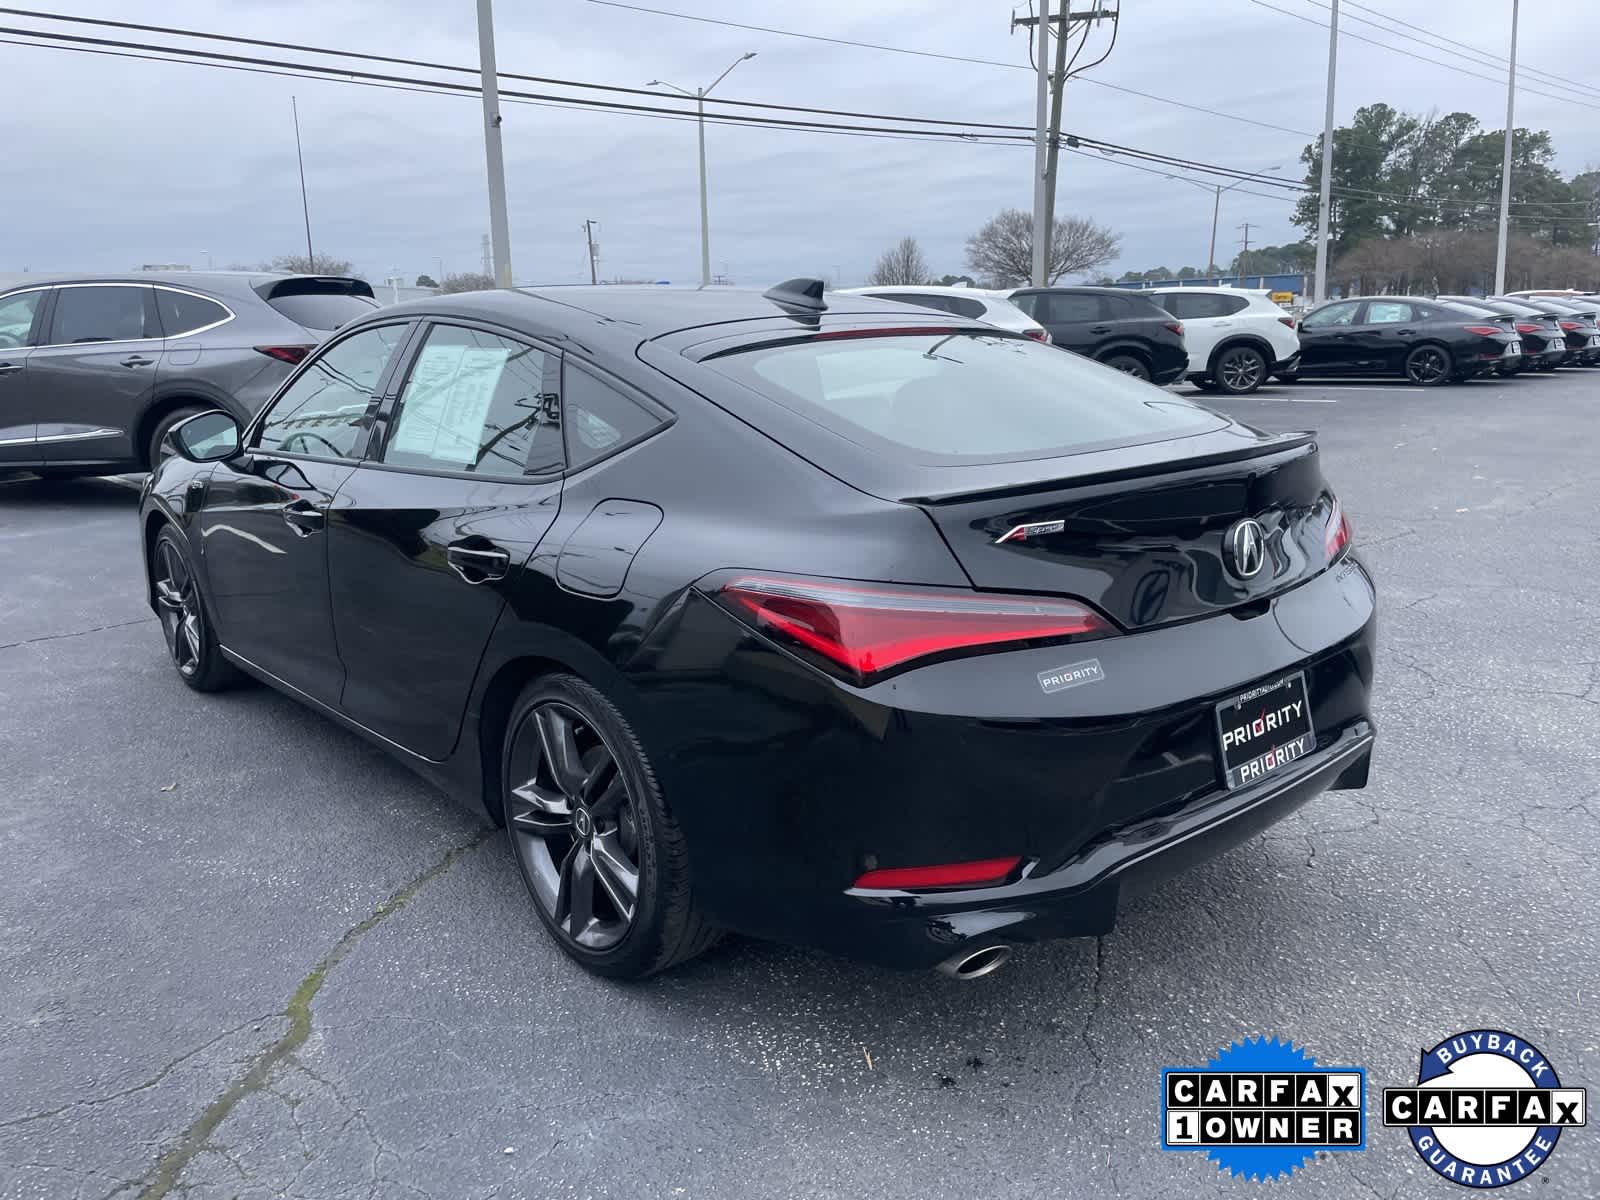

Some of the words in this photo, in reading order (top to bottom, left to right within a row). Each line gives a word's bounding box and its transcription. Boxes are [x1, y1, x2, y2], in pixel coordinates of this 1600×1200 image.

[1042, 666, 1099, 689] PRIORITY
[1222, 700, 1303, 752] PRIORITY
[1240, 738, 1306, 783] PRIORITY
